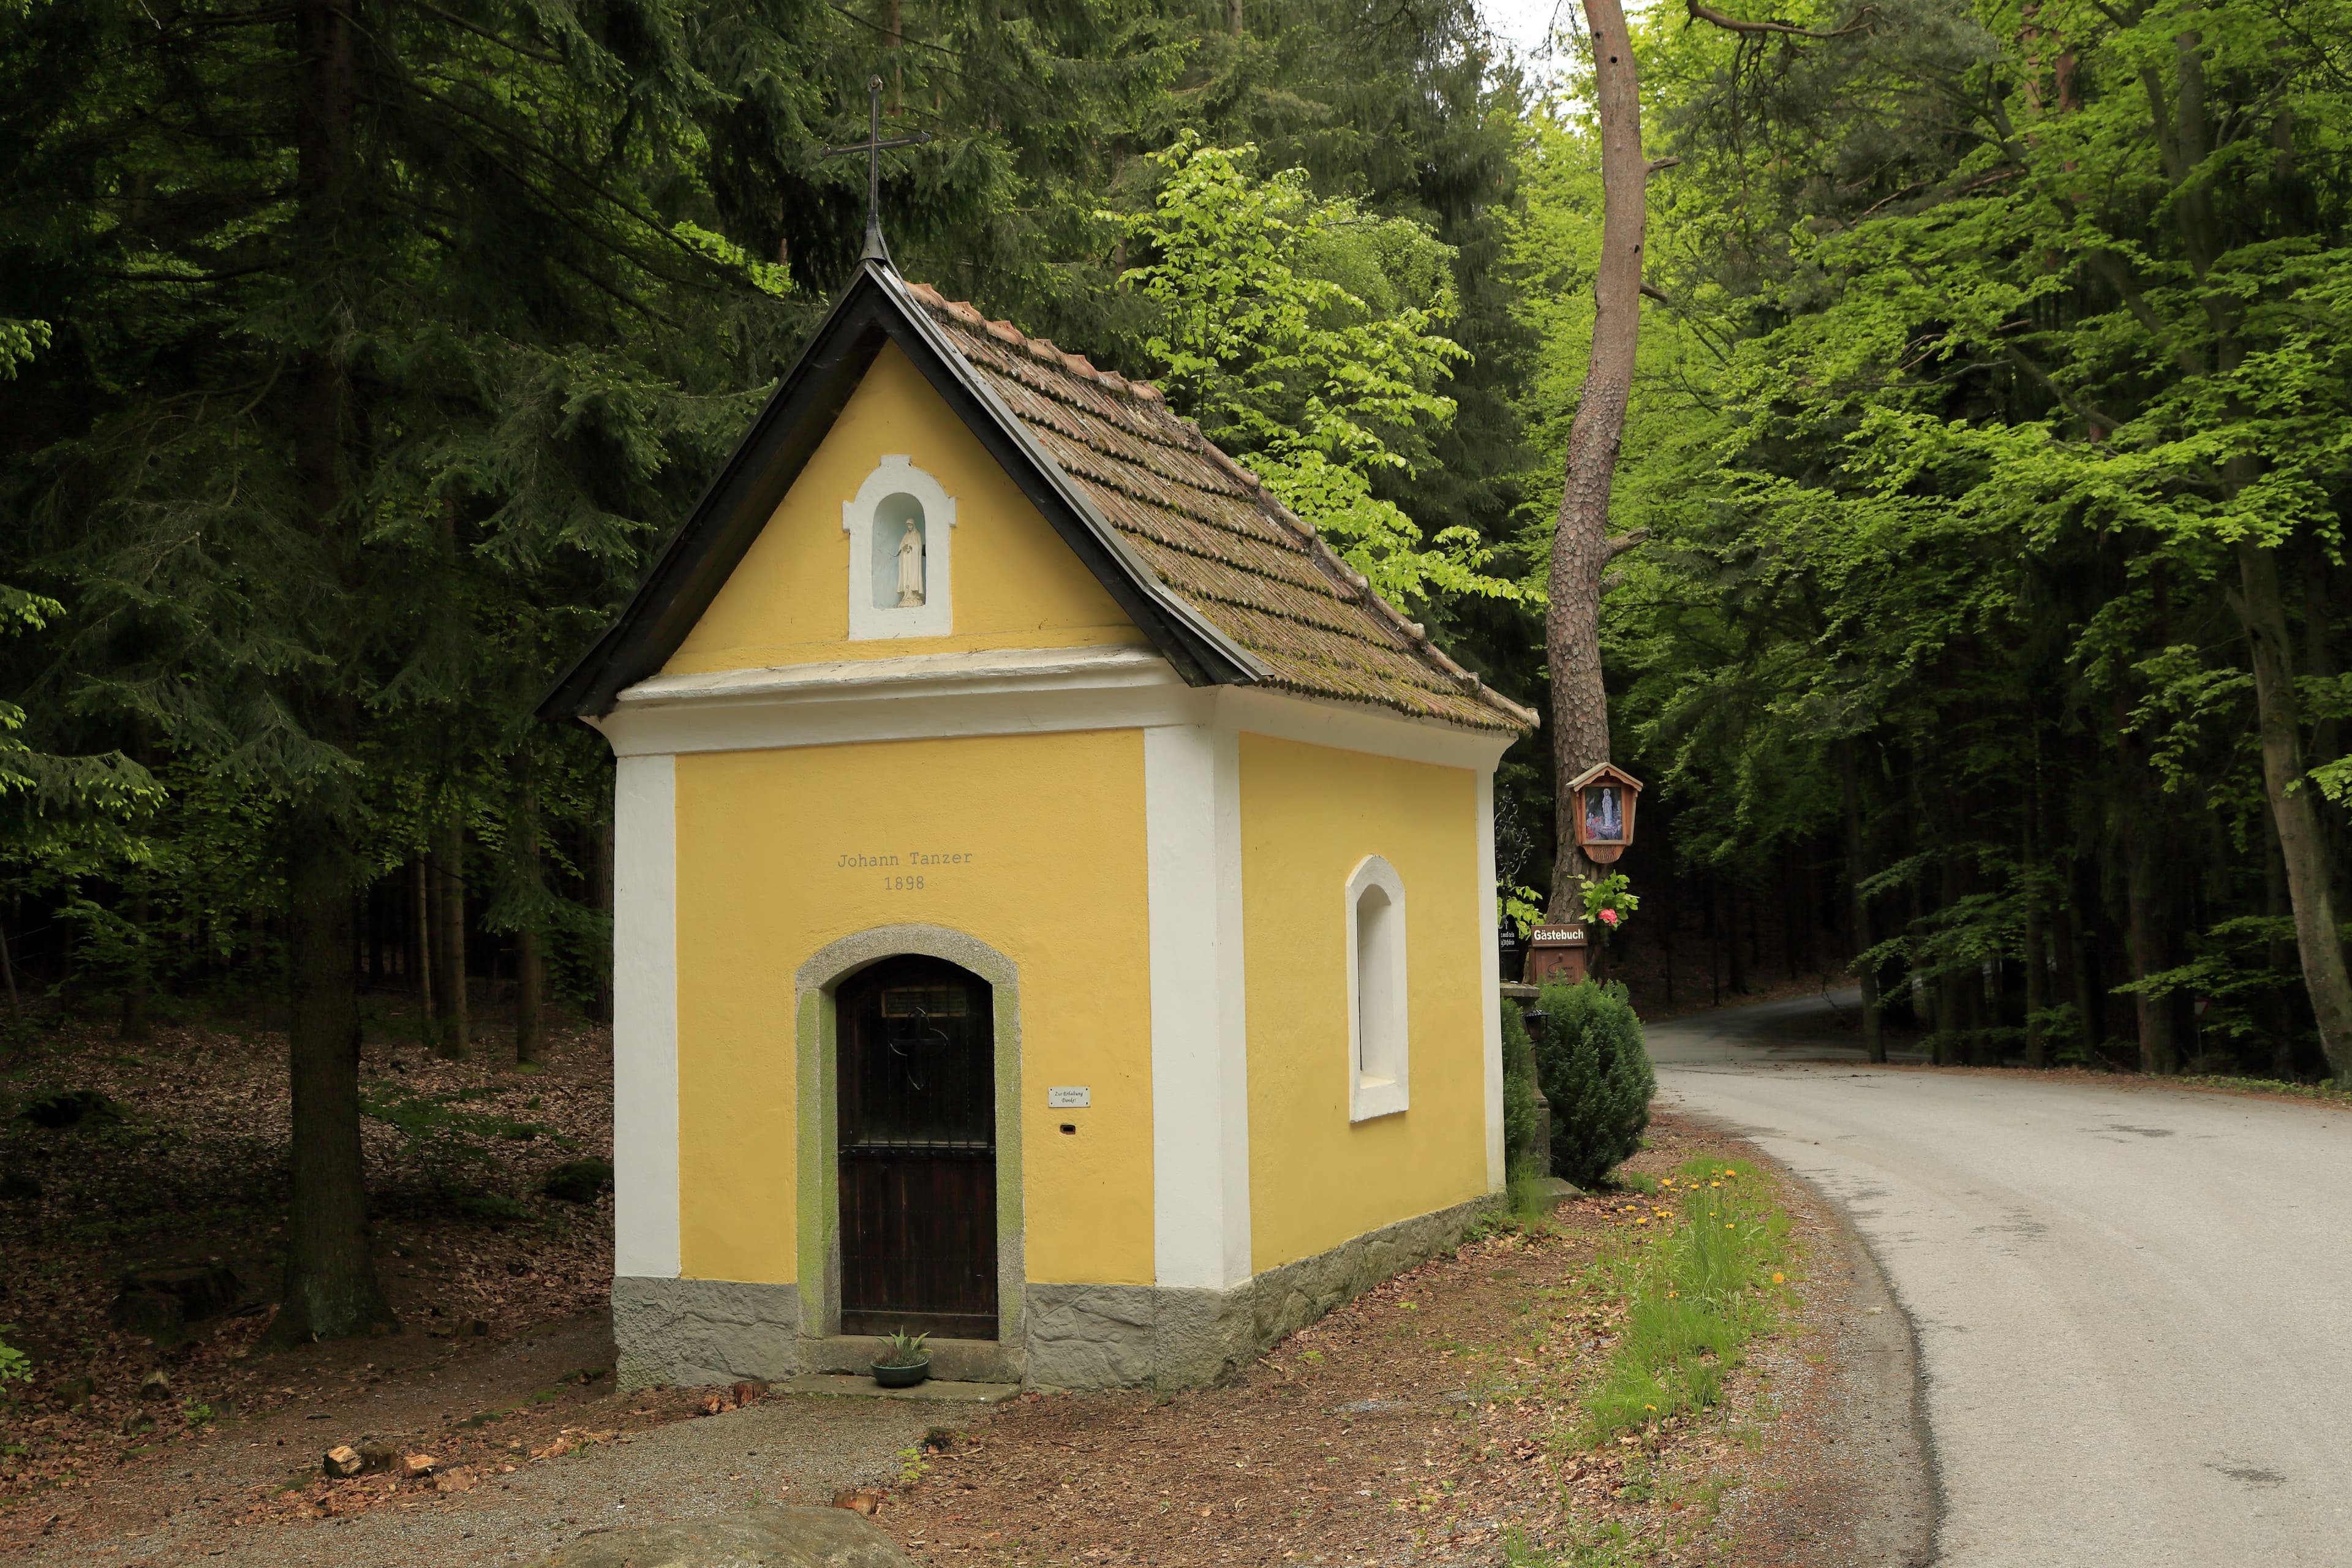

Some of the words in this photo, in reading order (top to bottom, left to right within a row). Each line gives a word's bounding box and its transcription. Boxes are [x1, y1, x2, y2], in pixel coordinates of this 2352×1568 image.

[837, 853, 899, 868] Johann
[910, 852, 973, 865] Tanzer
[884, 876, 925, 891] 1898
[1534, 929, 1584, 940] Gästebuch
